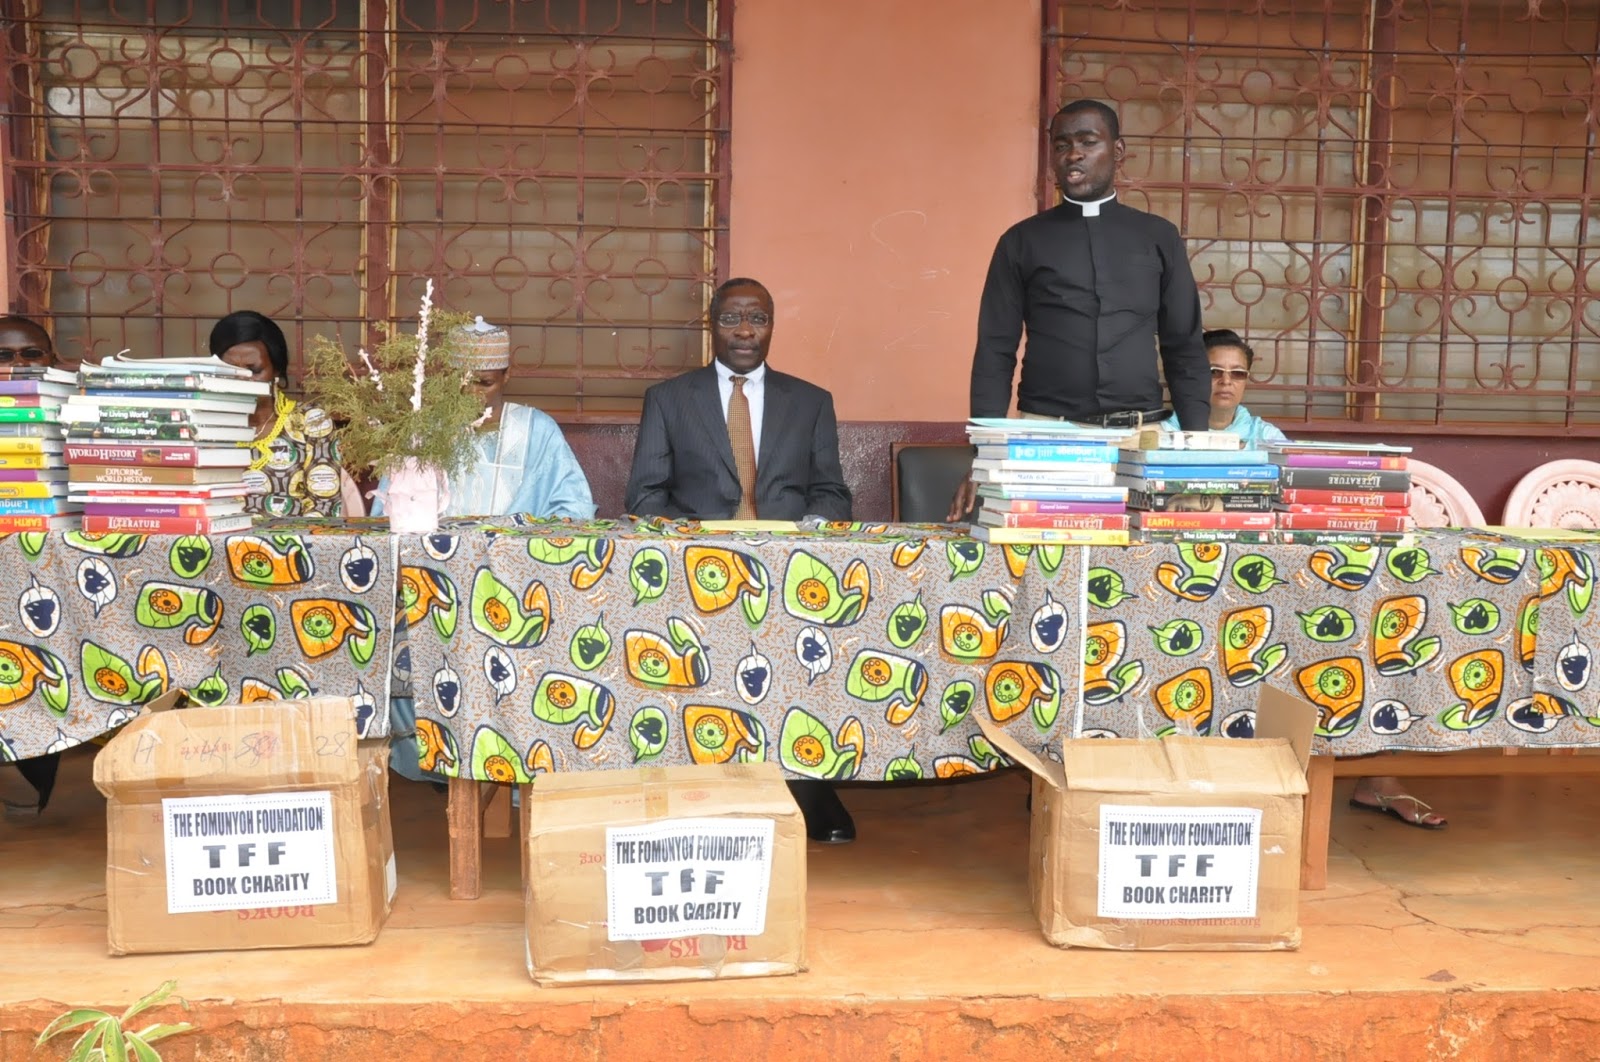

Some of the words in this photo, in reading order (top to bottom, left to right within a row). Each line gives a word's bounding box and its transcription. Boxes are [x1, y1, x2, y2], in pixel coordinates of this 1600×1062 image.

[116, 426, 136, 435] Living
[137, 427, 157, 435] World
[68, 448, 99, 459] WORLD
[100, 449, 137, 459] HISTORY
[105, 467, 143, 476] EXPLORING
[1328, 475, 1382, 487] LITERATURE
[0, 499, 29, 509] Langu
[1332, 494, 1384, 506] LITERATURE
[14, 517, 42, 527] EARTH
[107, 517, 160, 529] LITERATURE
[1053, 518, 1104, 529] LITERATURE
[1147, 518, 1174, 527] EARTH
[1327, 519, 1379, 531] LITERATURE
[1337, 535, 1358, 543] Living
[173, 812, 196, 838] THE
[197, 810, 253, 837] FOMUNYOH
[257, 806, 323, 834] FOUNDATION
[1109, 821, 1127, 846] THE
[1130, 821, 1186, 846] FOMUNYOH
[1188, 821, 1251, 847] FOUNDATION
[616, 841, 636, 864] THE
[193, 877, 237, 896] BOOK
[241, 873, 310, 894] CHARITY
[1123, 885, 1166, 904] BOOK
[1169, 885, 1233, 904] CHARITY
[634, 905, 679, 924] BOOK
